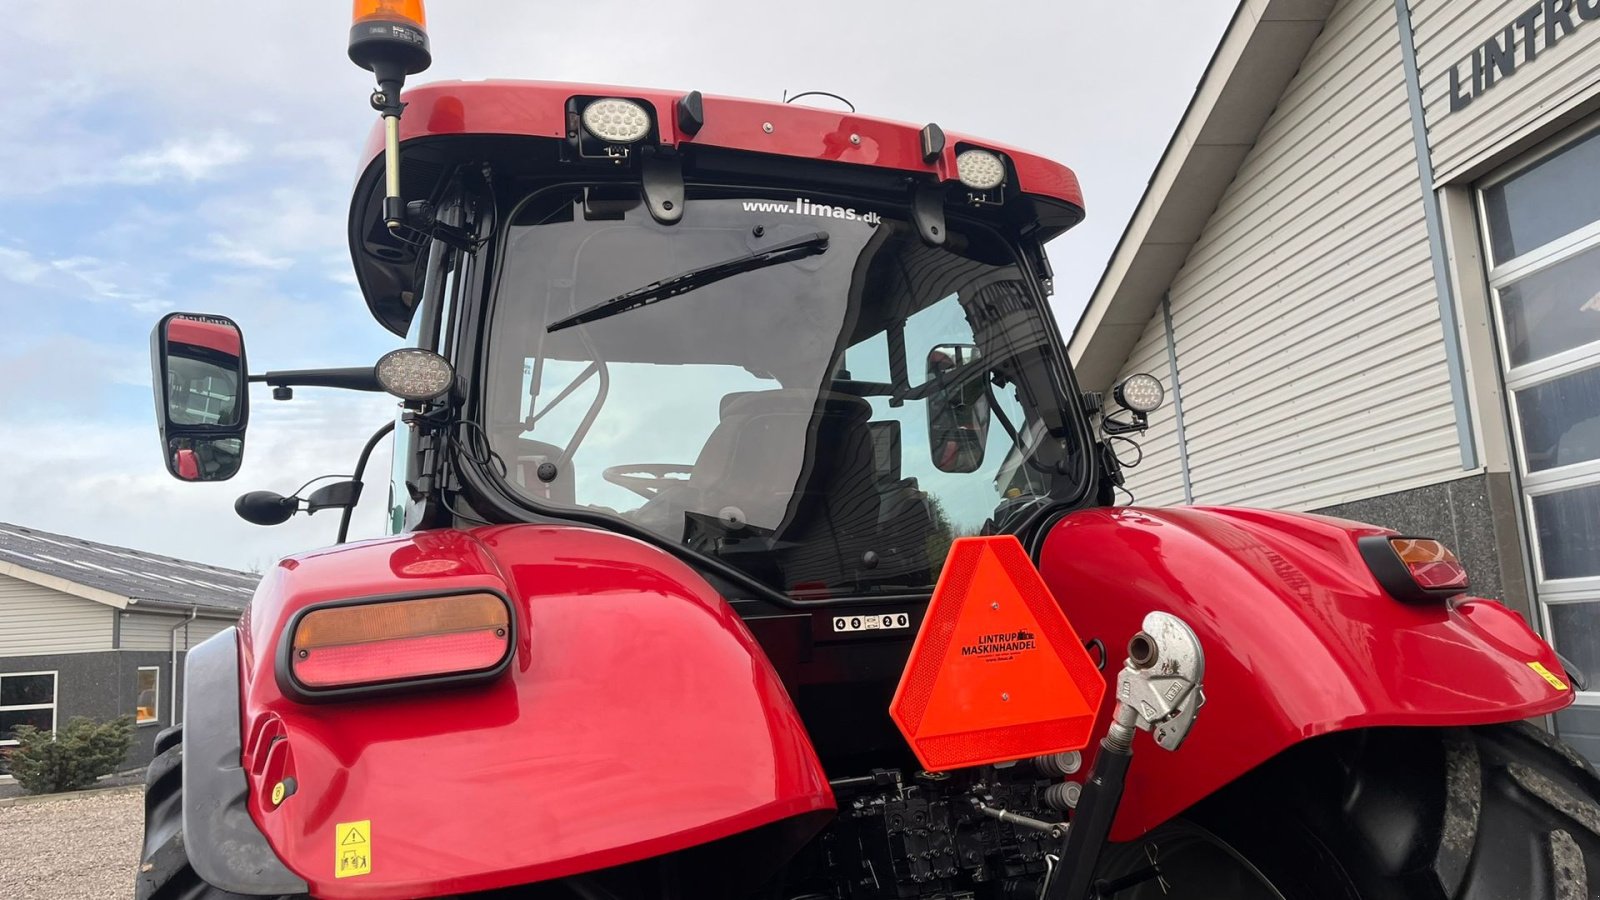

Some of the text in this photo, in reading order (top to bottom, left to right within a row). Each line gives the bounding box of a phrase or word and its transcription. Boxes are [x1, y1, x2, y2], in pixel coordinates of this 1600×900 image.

[742, 198, 881, 224] www.limas.dk
[978, 633, 1016, 644] LINTRUP
[961, 640, 1036, 656] MASKINHANDEL
